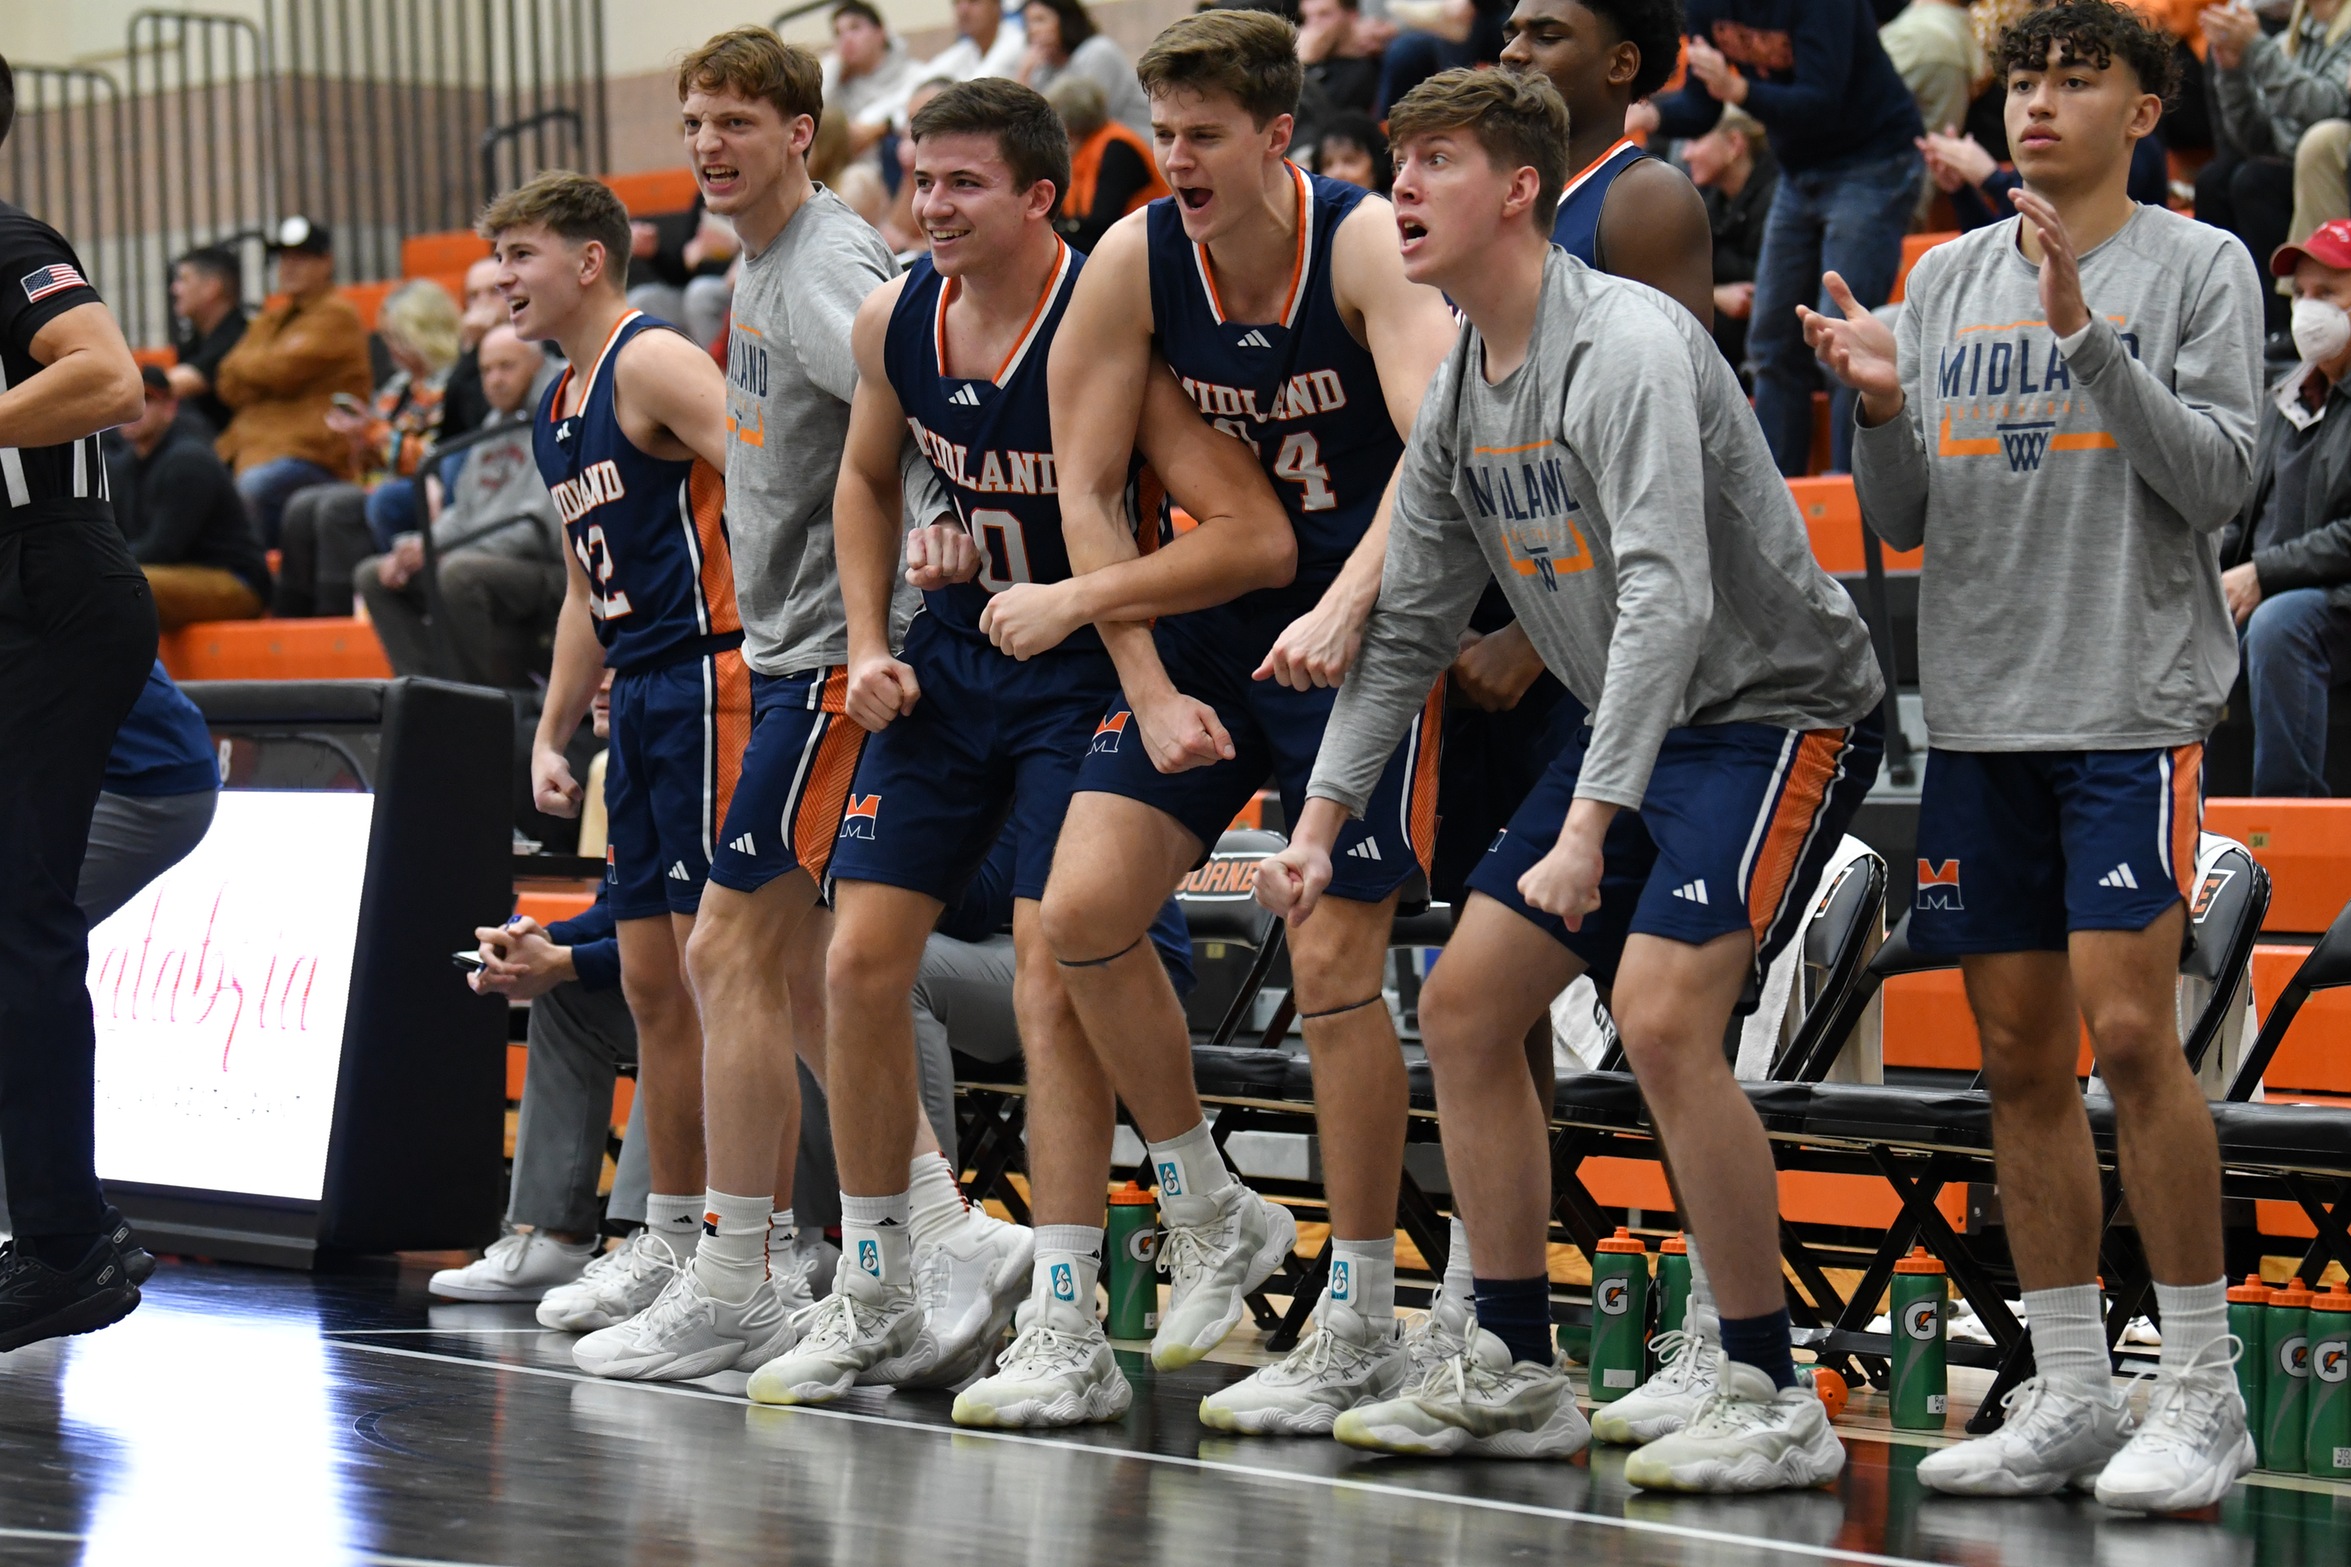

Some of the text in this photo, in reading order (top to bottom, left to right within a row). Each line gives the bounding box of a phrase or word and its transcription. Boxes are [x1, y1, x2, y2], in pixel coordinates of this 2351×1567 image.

[1937, 332, 2140, 399] MIDLA
[550, 459, 625, 525] IDLAND
[1596, 1277, 1629, 1316] G
[1903, 1300, 1939, 1341] G
[2312, 1340, 2348, 1384] G
